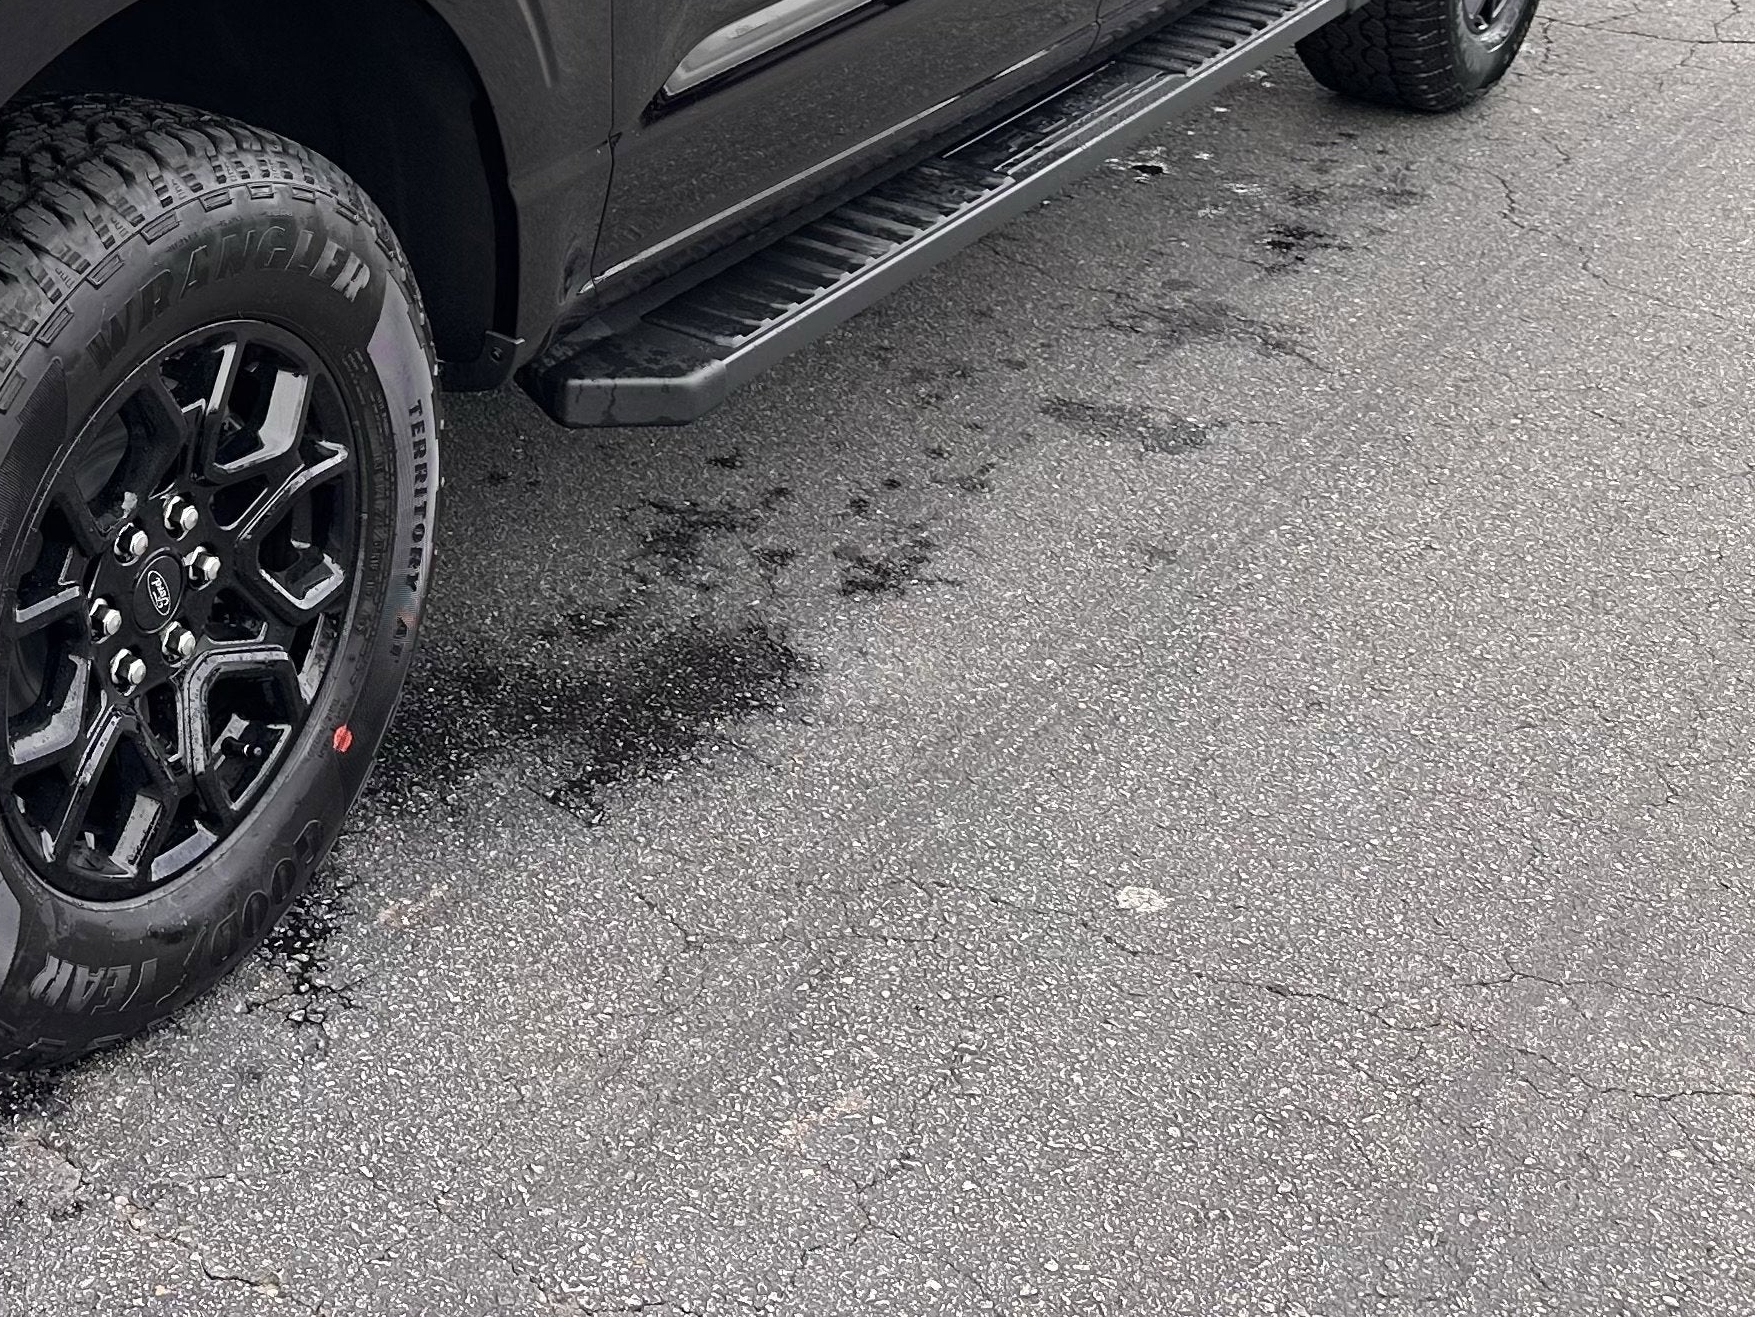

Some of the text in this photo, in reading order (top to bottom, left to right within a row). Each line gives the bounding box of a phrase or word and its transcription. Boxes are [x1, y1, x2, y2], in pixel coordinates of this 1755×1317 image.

[85, 225, 372, 374] WRANGLER
[407, 399, 428, 593] TERRITORY
[151, 577, 170, 609] Ford
